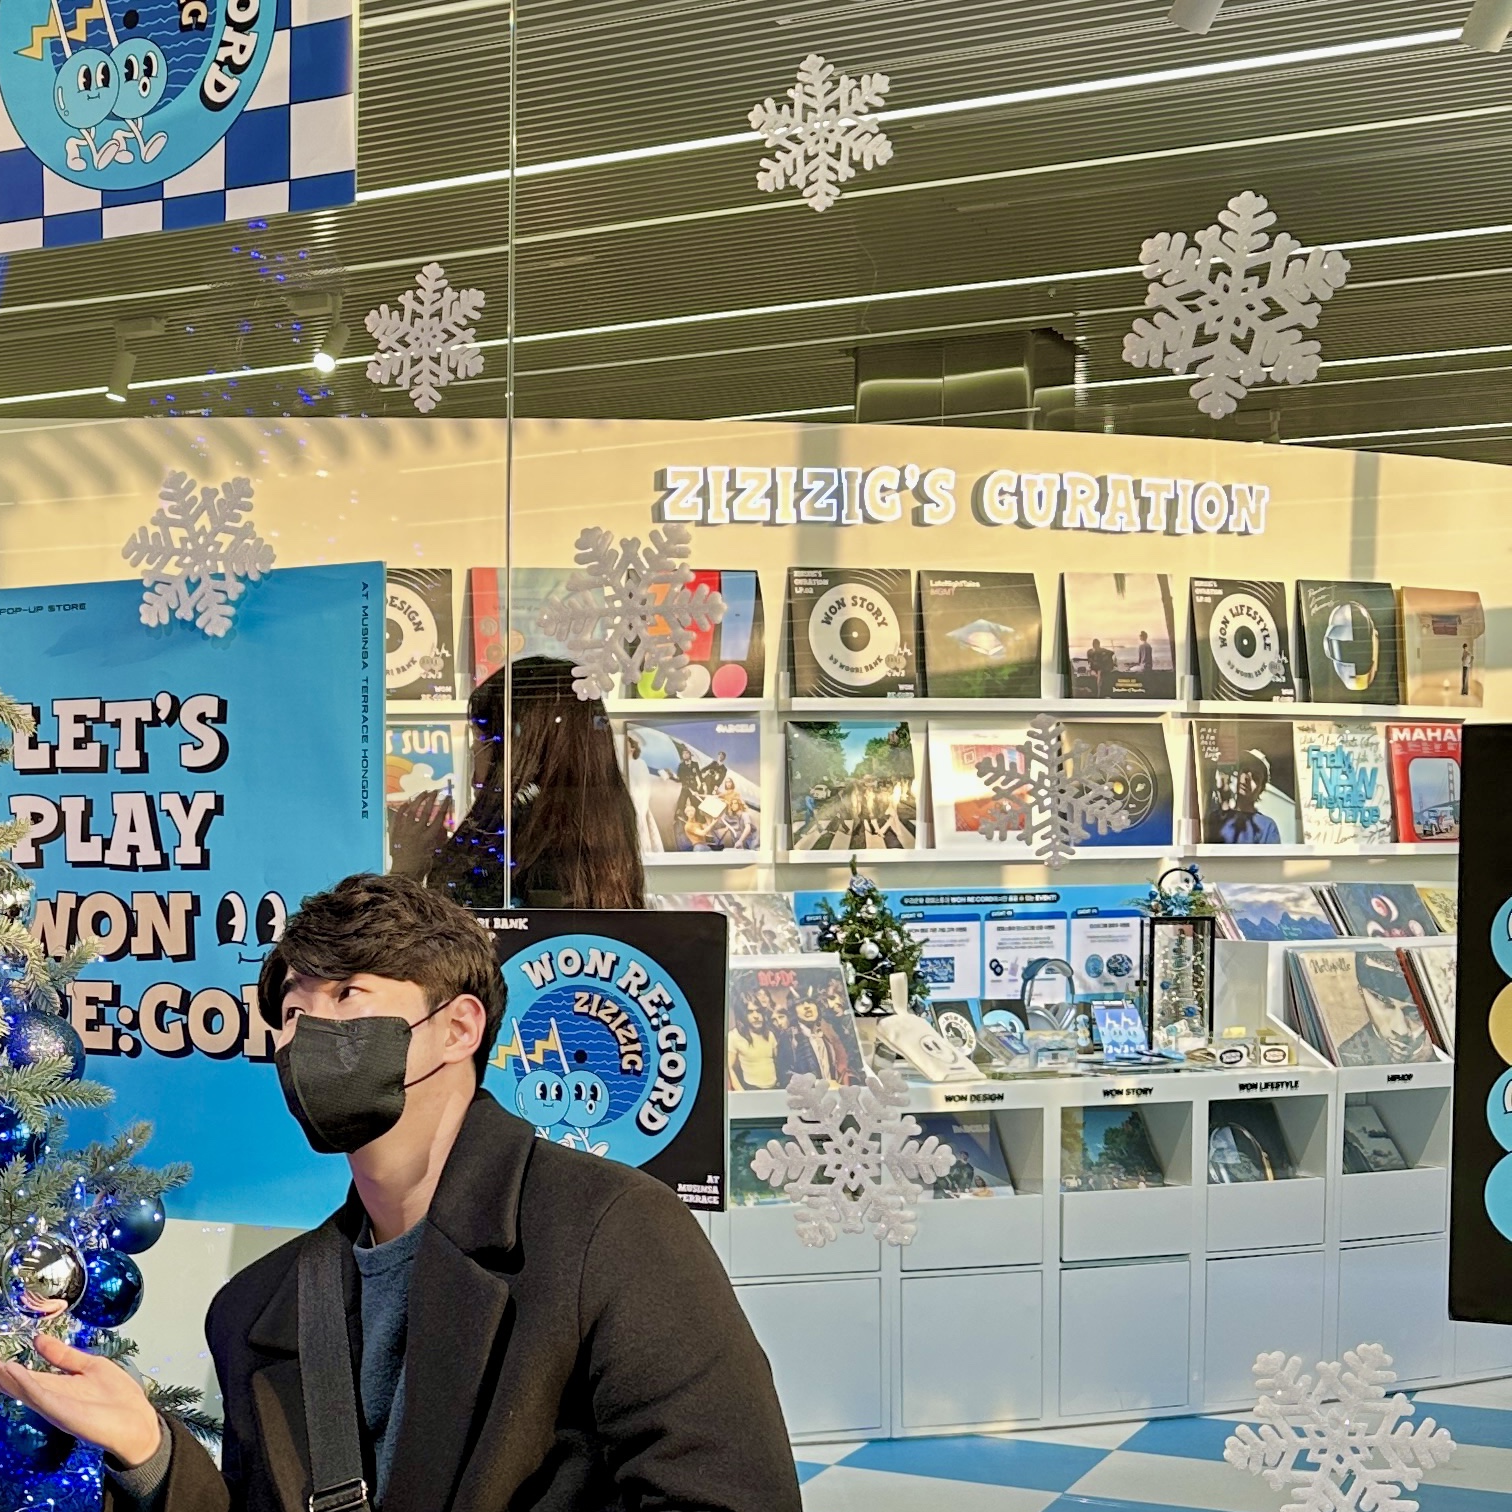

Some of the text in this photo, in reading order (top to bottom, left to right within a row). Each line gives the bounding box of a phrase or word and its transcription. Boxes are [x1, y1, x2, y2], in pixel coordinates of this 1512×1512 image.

[975, 470, 1270, 534] CURATION
[0, 603, 86, 615] POP-UP STORE
[387, 596, 424, 632] ESIGN
[821, 595, 888, 628] WON STORY
[1219, 604, 1272, 651] WON LIFESTYLE
[361, 581, 369, 820] AT MUSINSA TERRACE HONGDAE
[11, 691, 229, 773] LET'S
[9, 790, 224, 870] PLAY
[30, 891, 201, 963] WON
[493, 917, 528, 930] BANK
[519, 947, 688, 1136] WON RE:CORD
[970, 1092, 1004, 1103] DESIGN
[1103, 1087, 1154, 1098] WON STORY
[1260, 1080, 1299, 1091] LIFESTYLE
[677, 1183, 719, 1195] MUSINSA
[706, 1174, 720, 1184] AT
